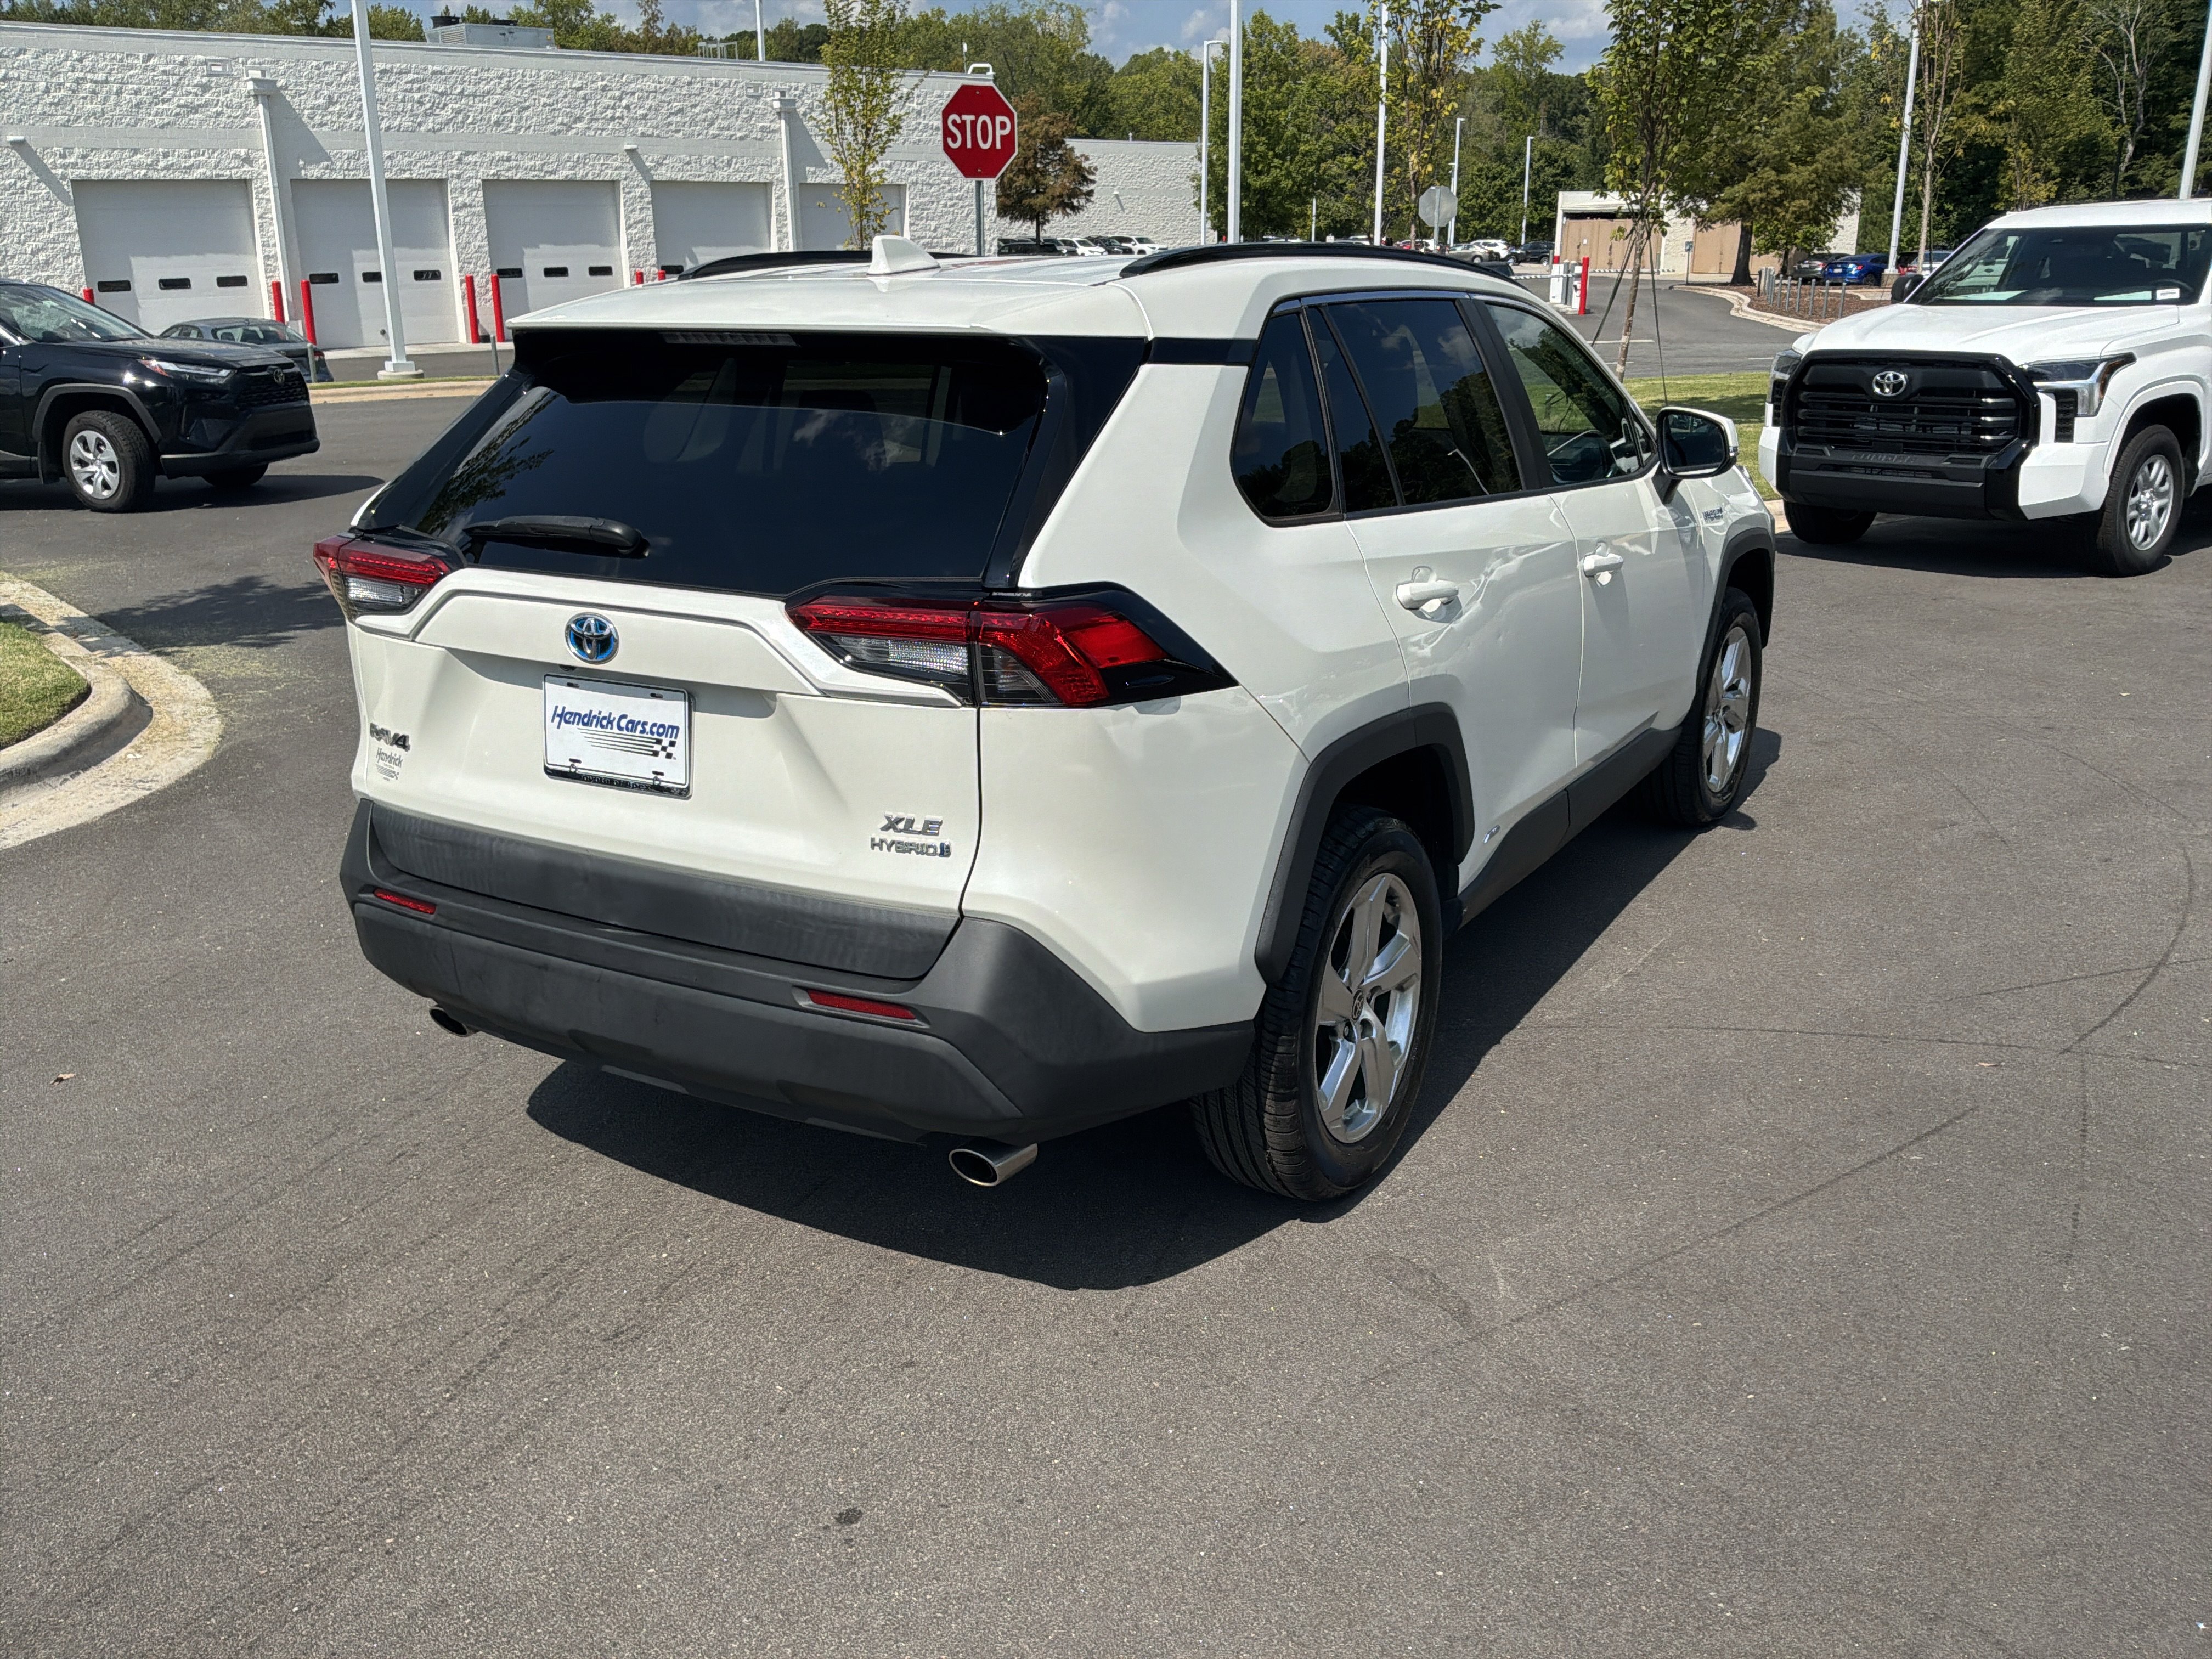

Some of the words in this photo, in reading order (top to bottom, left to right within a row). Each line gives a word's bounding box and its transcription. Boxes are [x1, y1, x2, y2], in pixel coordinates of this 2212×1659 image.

[947, 114, 1011, 150] STOP
[376, 747, 403, 768] Hendrick
[879, 812, 943, 837] XLE
[870, 835, 938, 856] HYBRID
